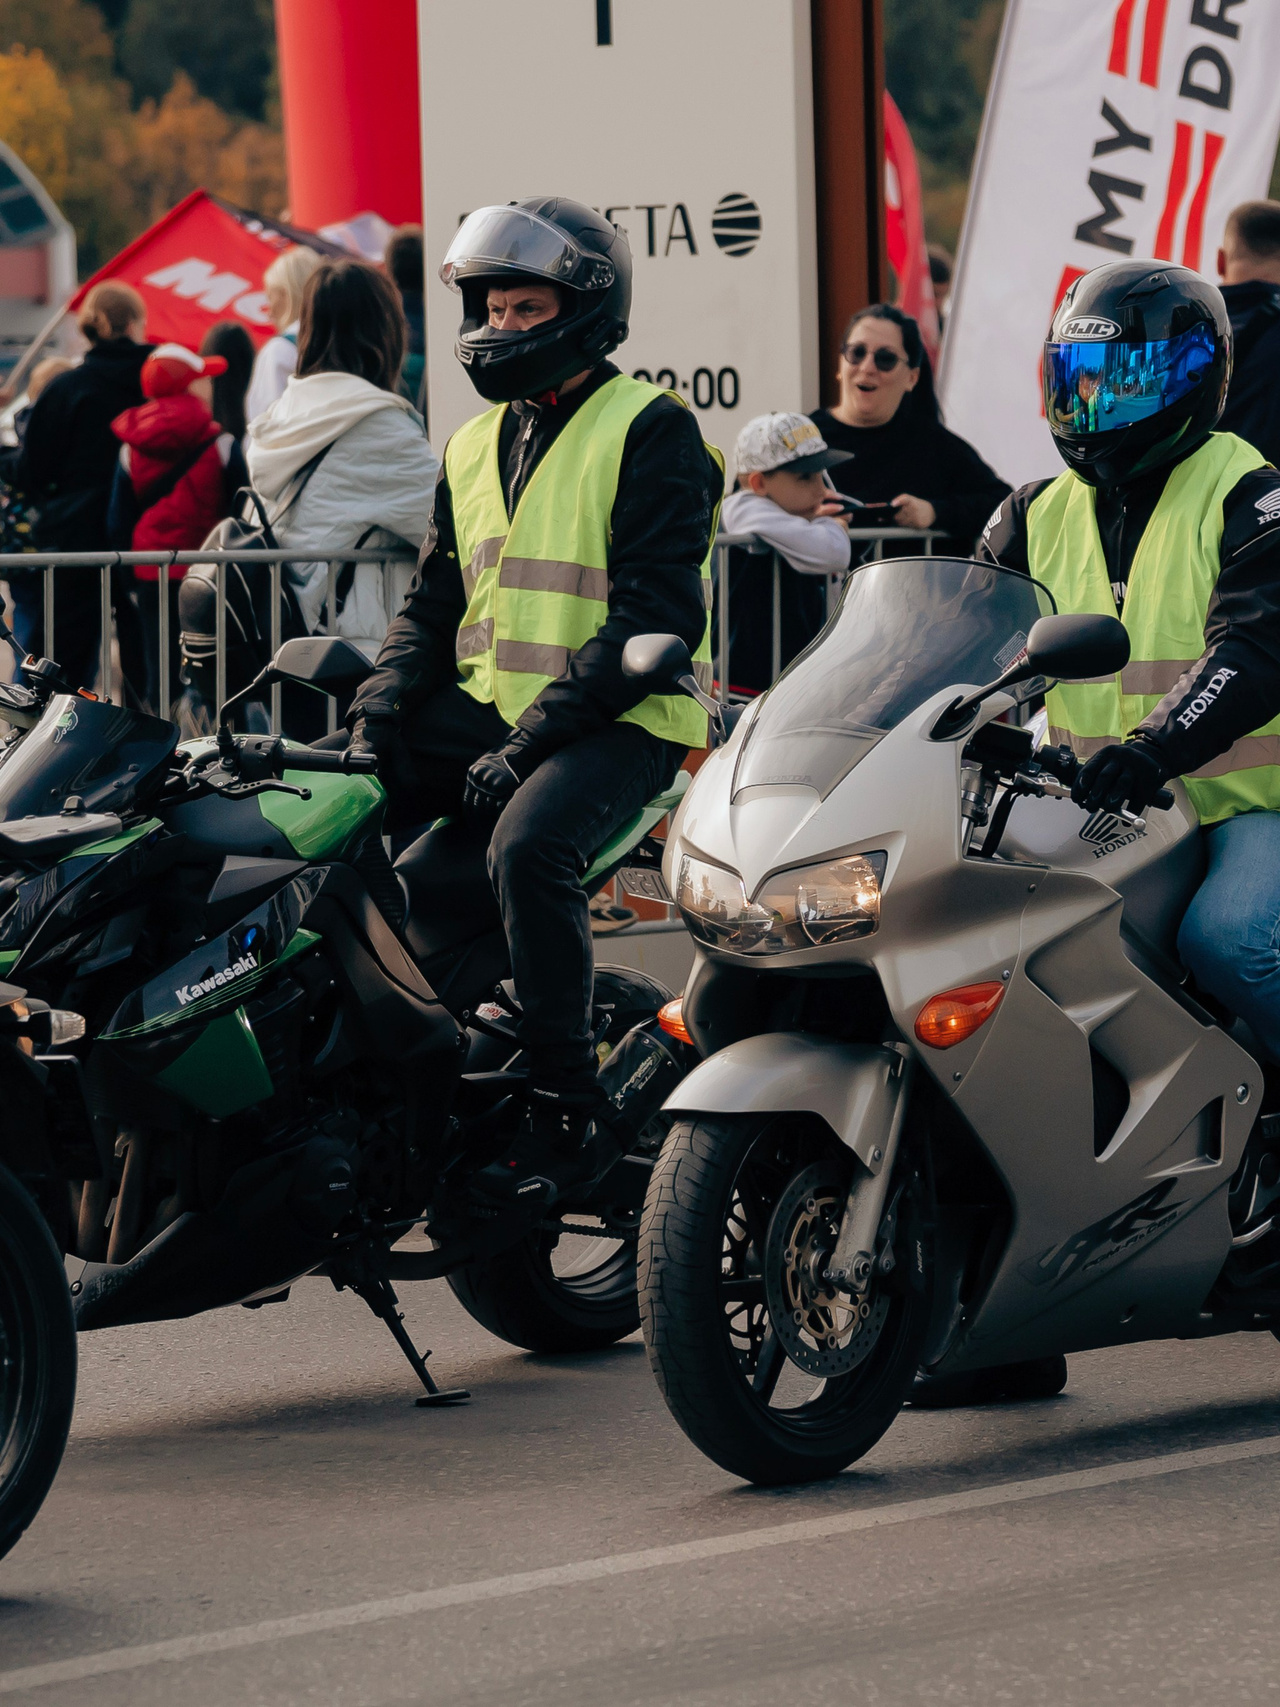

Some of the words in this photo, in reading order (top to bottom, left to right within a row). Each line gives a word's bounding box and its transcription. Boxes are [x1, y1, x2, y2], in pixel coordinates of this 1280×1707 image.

[1074, 97, 1154, 256] MY
[1064, 322, 1112, 336] HJC
[1176, 666, 1239, 731] HONDA
[1091, 831, 1149, 860] HONDA
[175, 951, 259, 1006] Kawasaki
